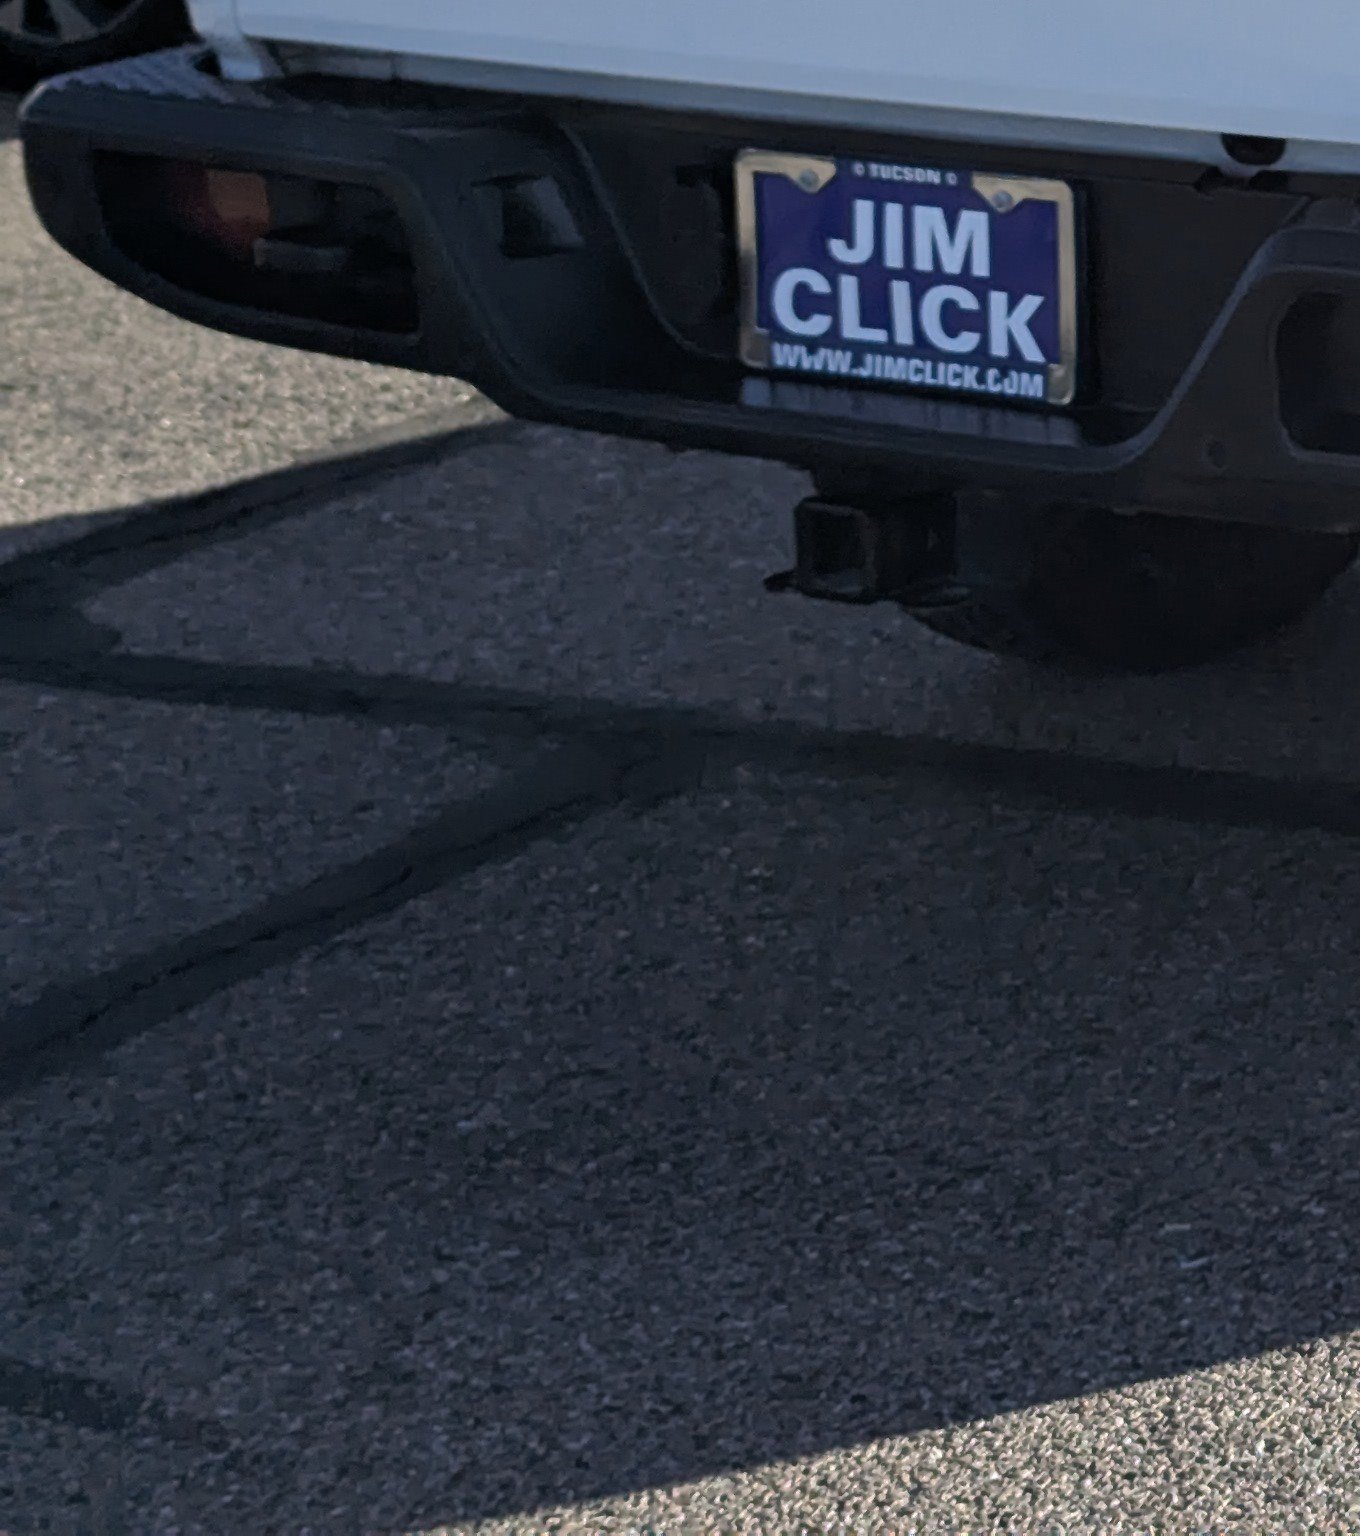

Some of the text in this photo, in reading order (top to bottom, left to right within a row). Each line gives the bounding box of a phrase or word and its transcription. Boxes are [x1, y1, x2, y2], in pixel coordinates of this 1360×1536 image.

[868, 163, 941, 183] TUCSON
[828, 199, 991, 278] JIM
[772, 267, 1046, 363] CLICK
[772, 343, 1044, 398] WWW.JIMCLICK.COM
